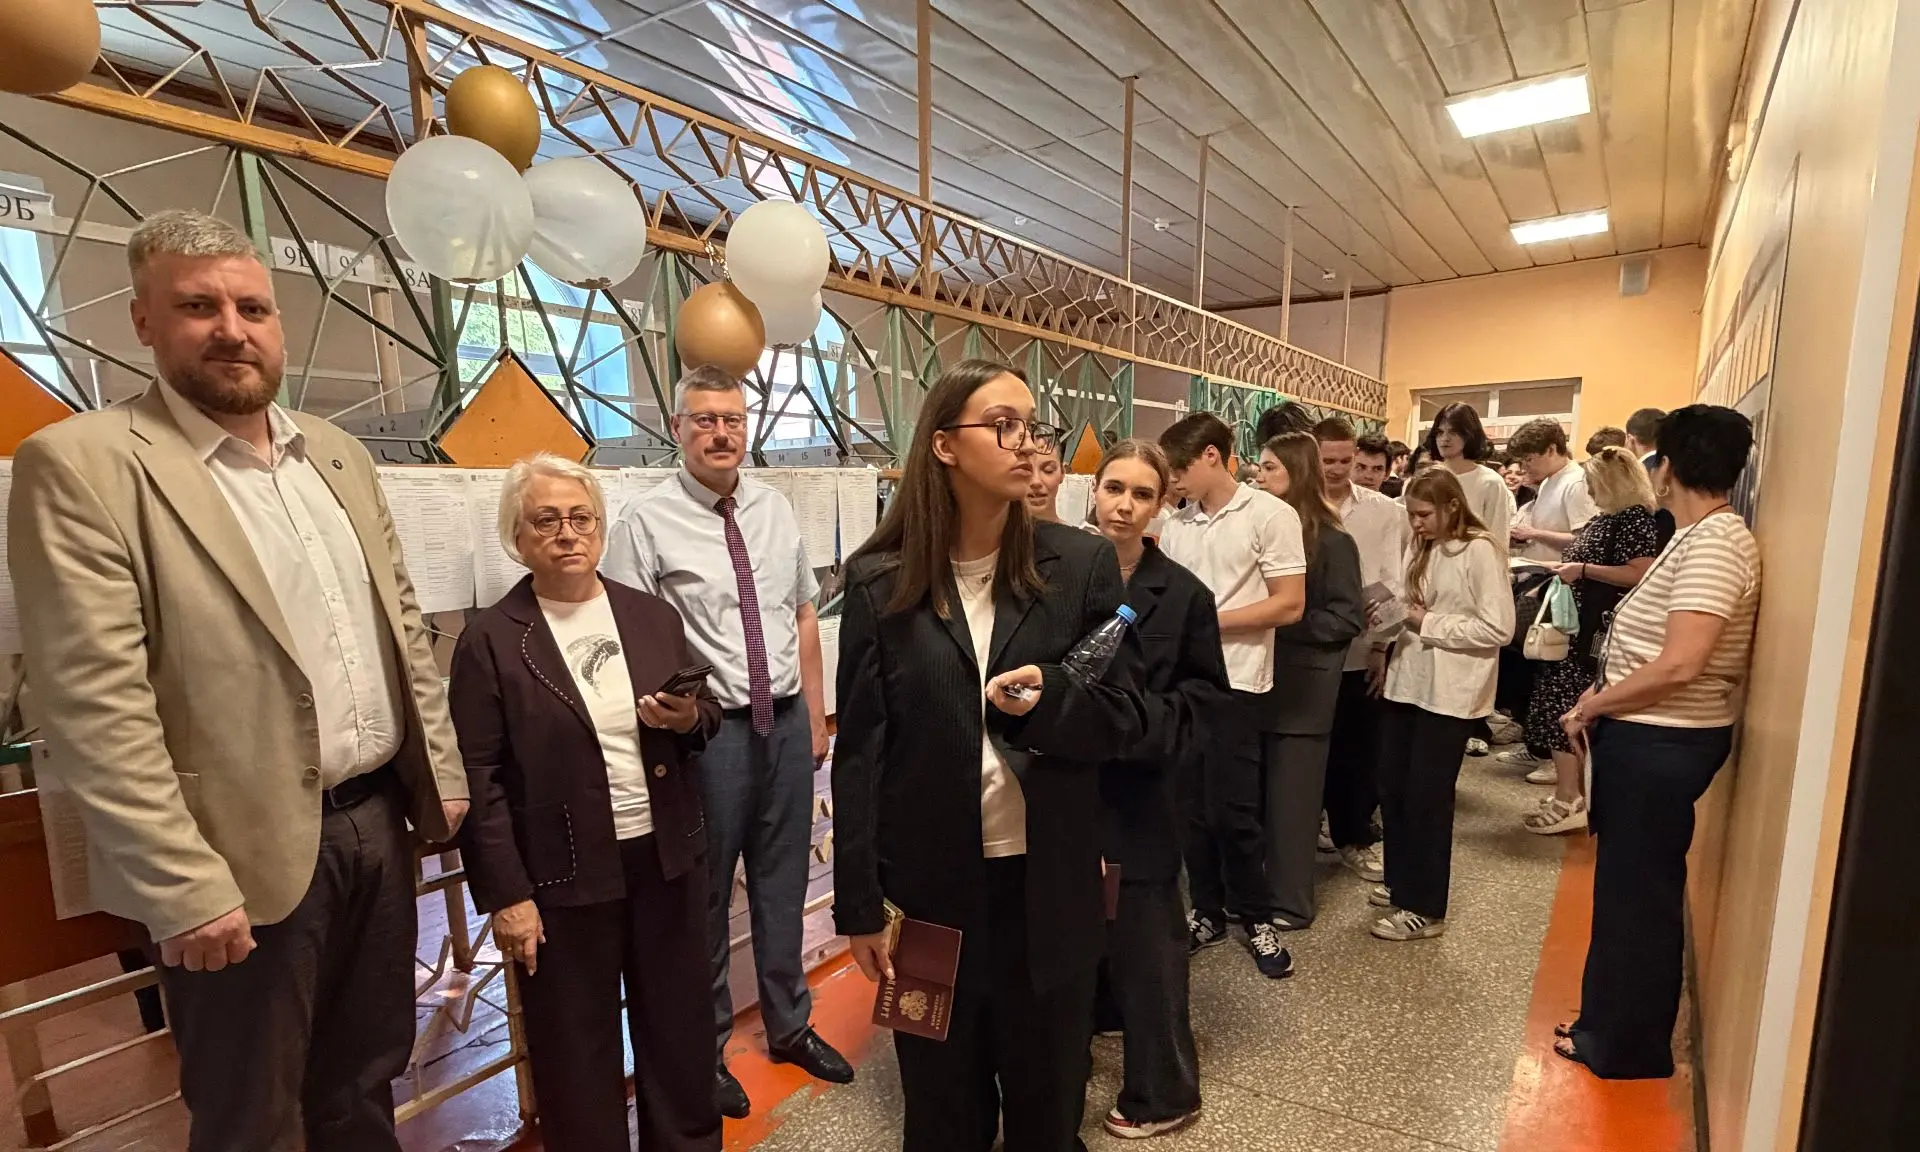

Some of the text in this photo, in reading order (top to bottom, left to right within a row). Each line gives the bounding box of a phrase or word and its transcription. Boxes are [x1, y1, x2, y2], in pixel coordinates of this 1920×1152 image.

[0, 194, 35, 221] 9Б
[405, 267, 432, 289] 8А
[801, 451, 809, 461] 15
[823, 448, 832, 457] 16
